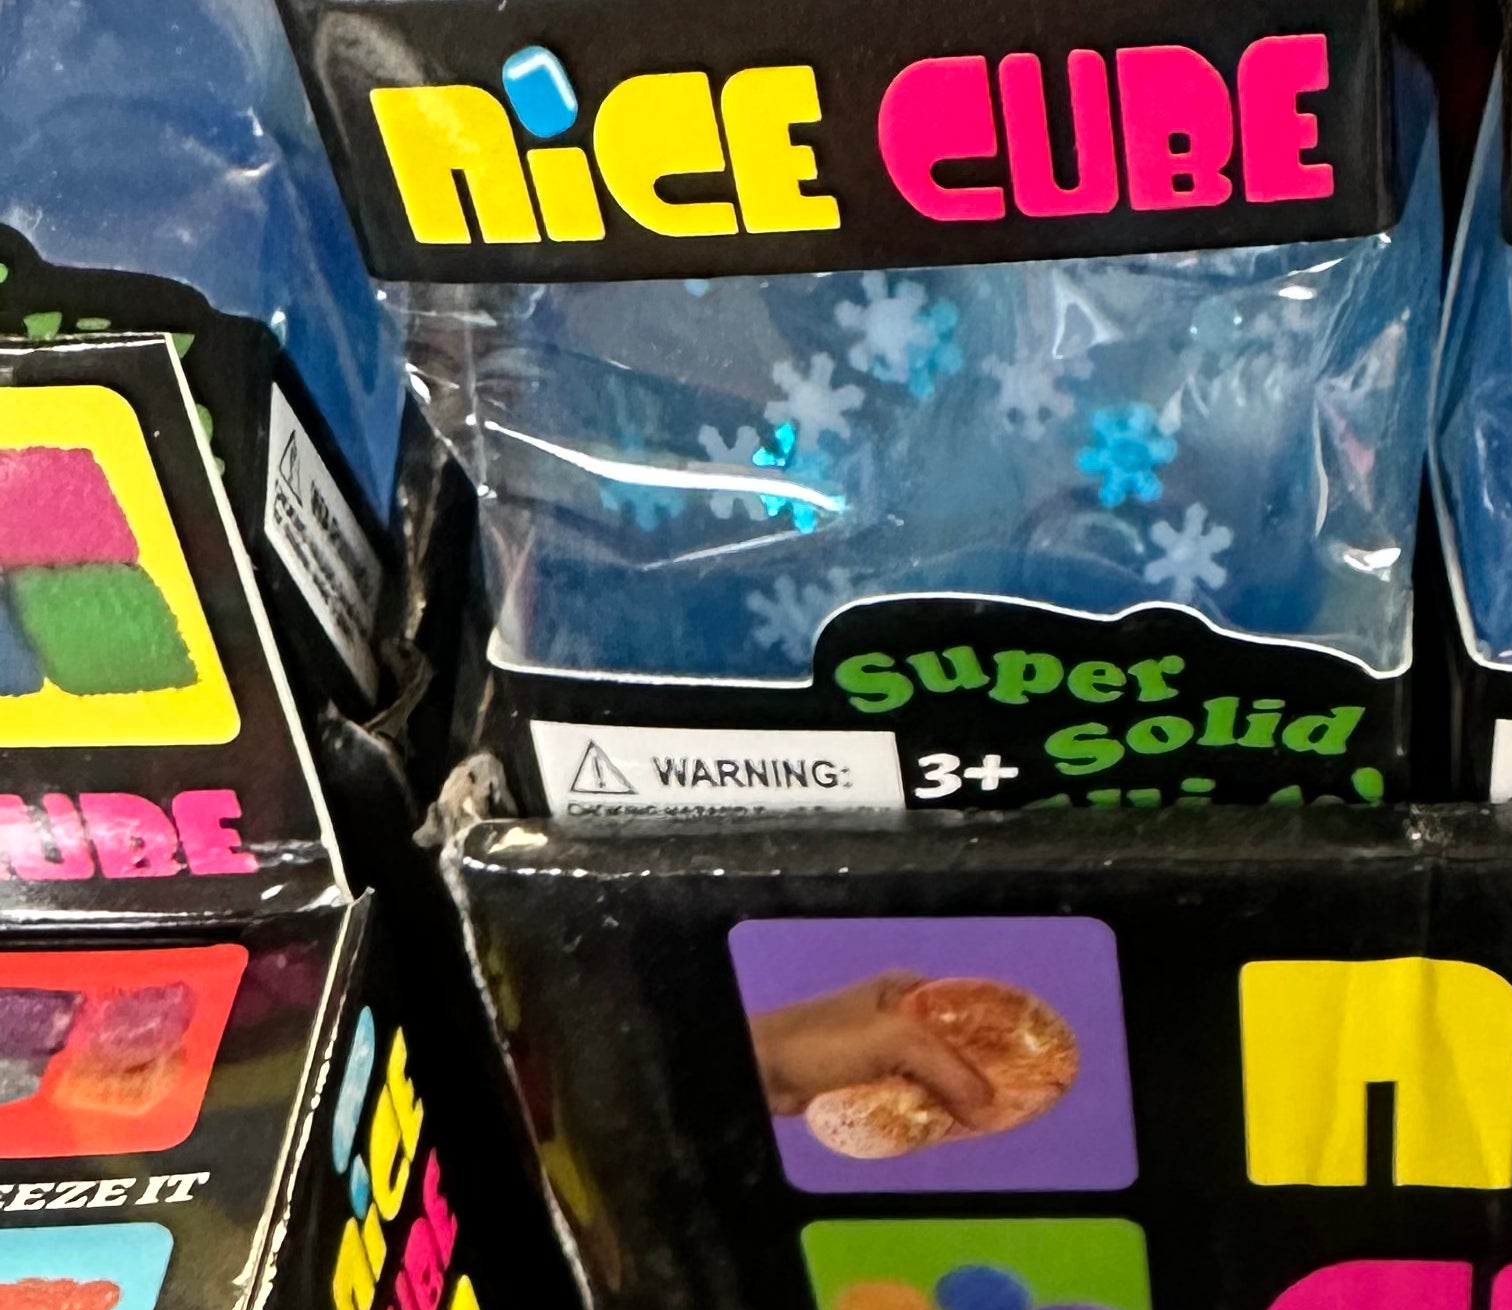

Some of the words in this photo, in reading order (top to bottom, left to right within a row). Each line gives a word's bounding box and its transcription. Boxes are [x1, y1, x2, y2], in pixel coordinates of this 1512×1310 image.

[877, 33, 1335, 222] CUBE
[834, 645, 1186, 714] Super
[1044, 698, 1367, 776] Solid
[652, 756, 852, 790] WARNING:
[914, 753, 1020, 799] 3+
[0, 789, 259, 881] UBE
[0, 1177, 137, 1212] EZE
[134, 1171, 211, 1206] IT
